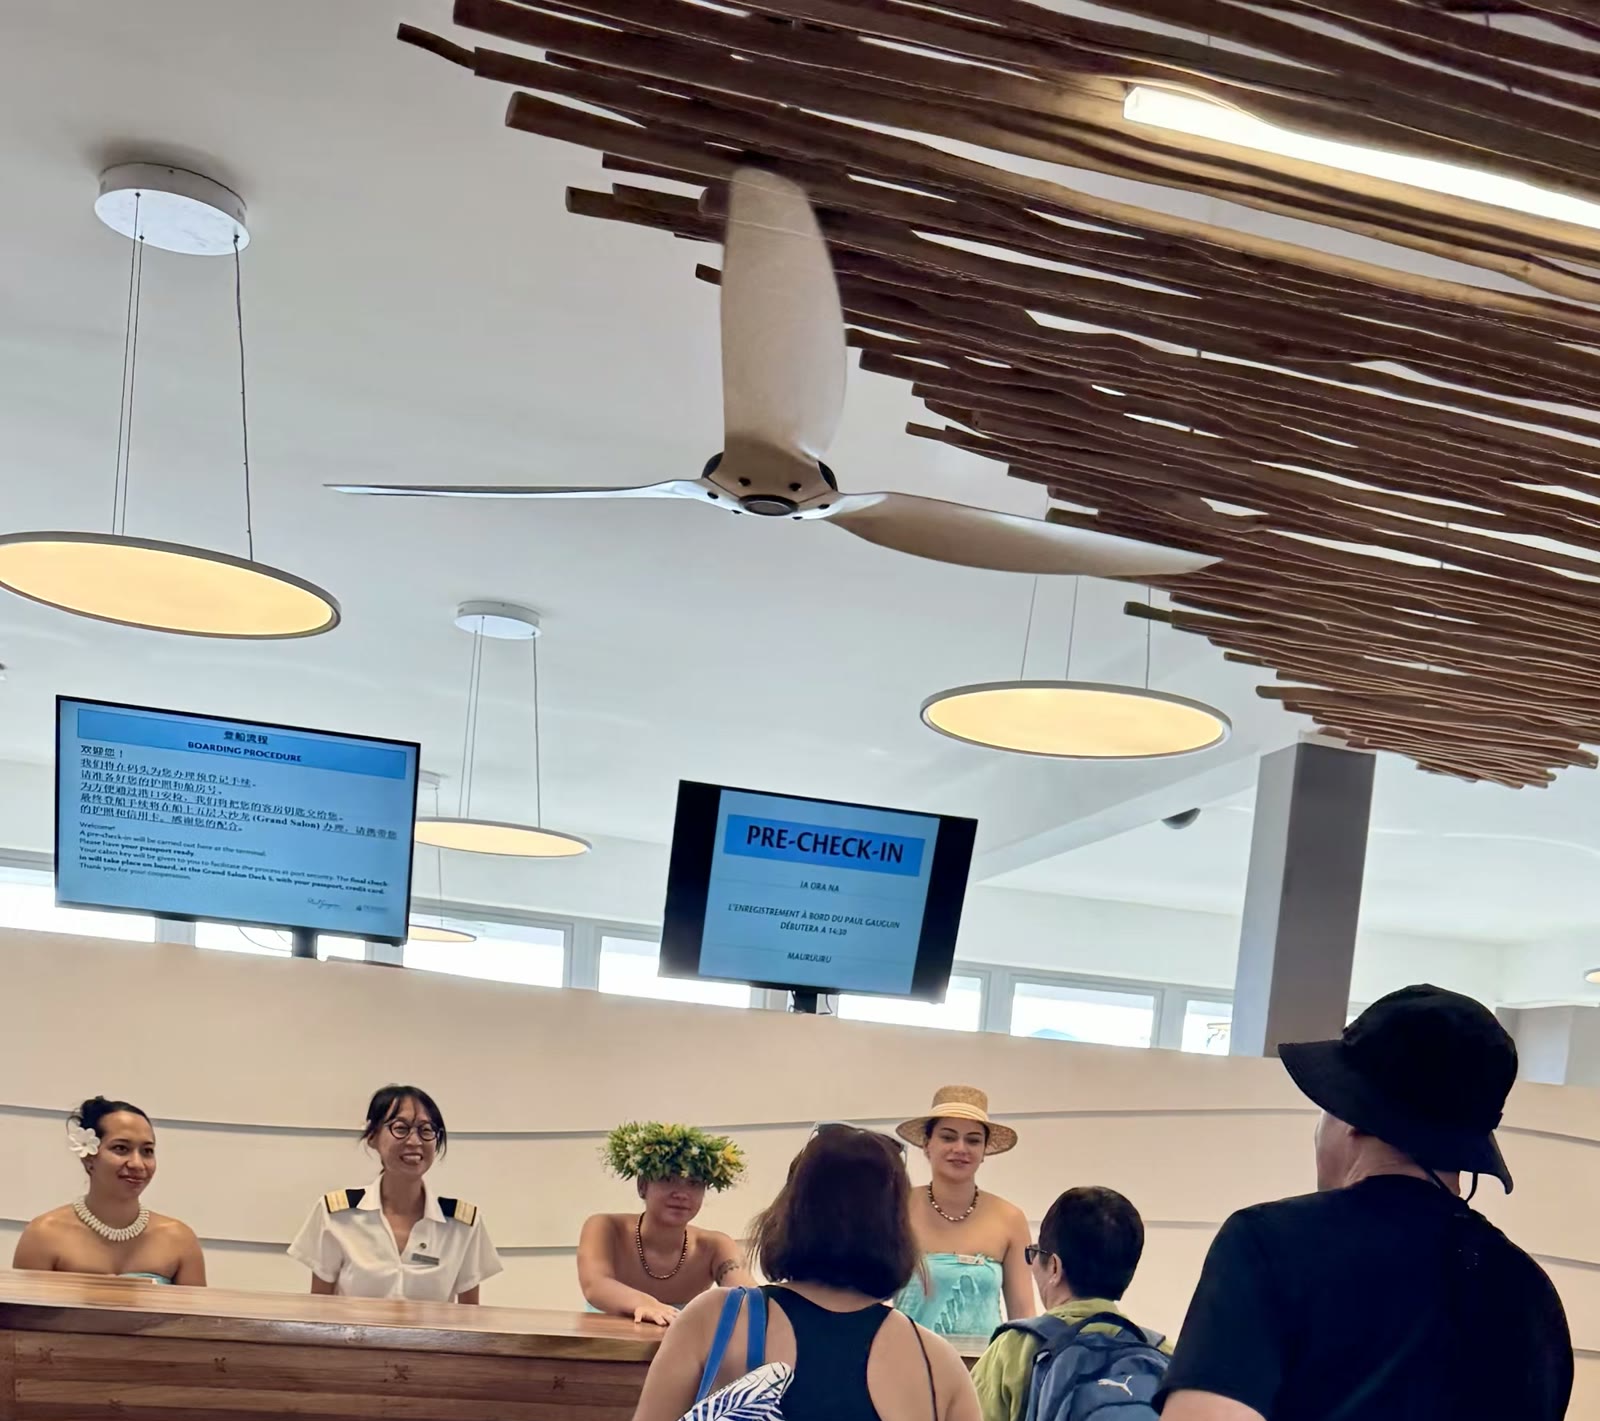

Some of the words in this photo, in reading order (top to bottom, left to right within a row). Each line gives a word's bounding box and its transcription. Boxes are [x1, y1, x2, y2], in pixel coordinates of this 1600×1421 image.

[188, 741, 241, 755] BOARDING
[244, 748, 302, 763] PROCEDURE
[252, 814, 287, 826] (Grand
[290, 819, 320, 830] Salon)
[746, 825, 904, 863] PRE-CHECK-IN
[810, 882, 827, 891] ORA
[828, 884, 840, 893] NA
[728, 903, 800, 918] L'ENREGISTREMENT
[809, 912, 830, 921] BORD
[831, 915, 843, 923] DU
[844, 916, 864, 925] PAUL
[865, 918, 900, 929] GAUGUIN
[780, 920, 819, 933] DÉBUTERA
[787, 952, 832, 964] MAURUURU
